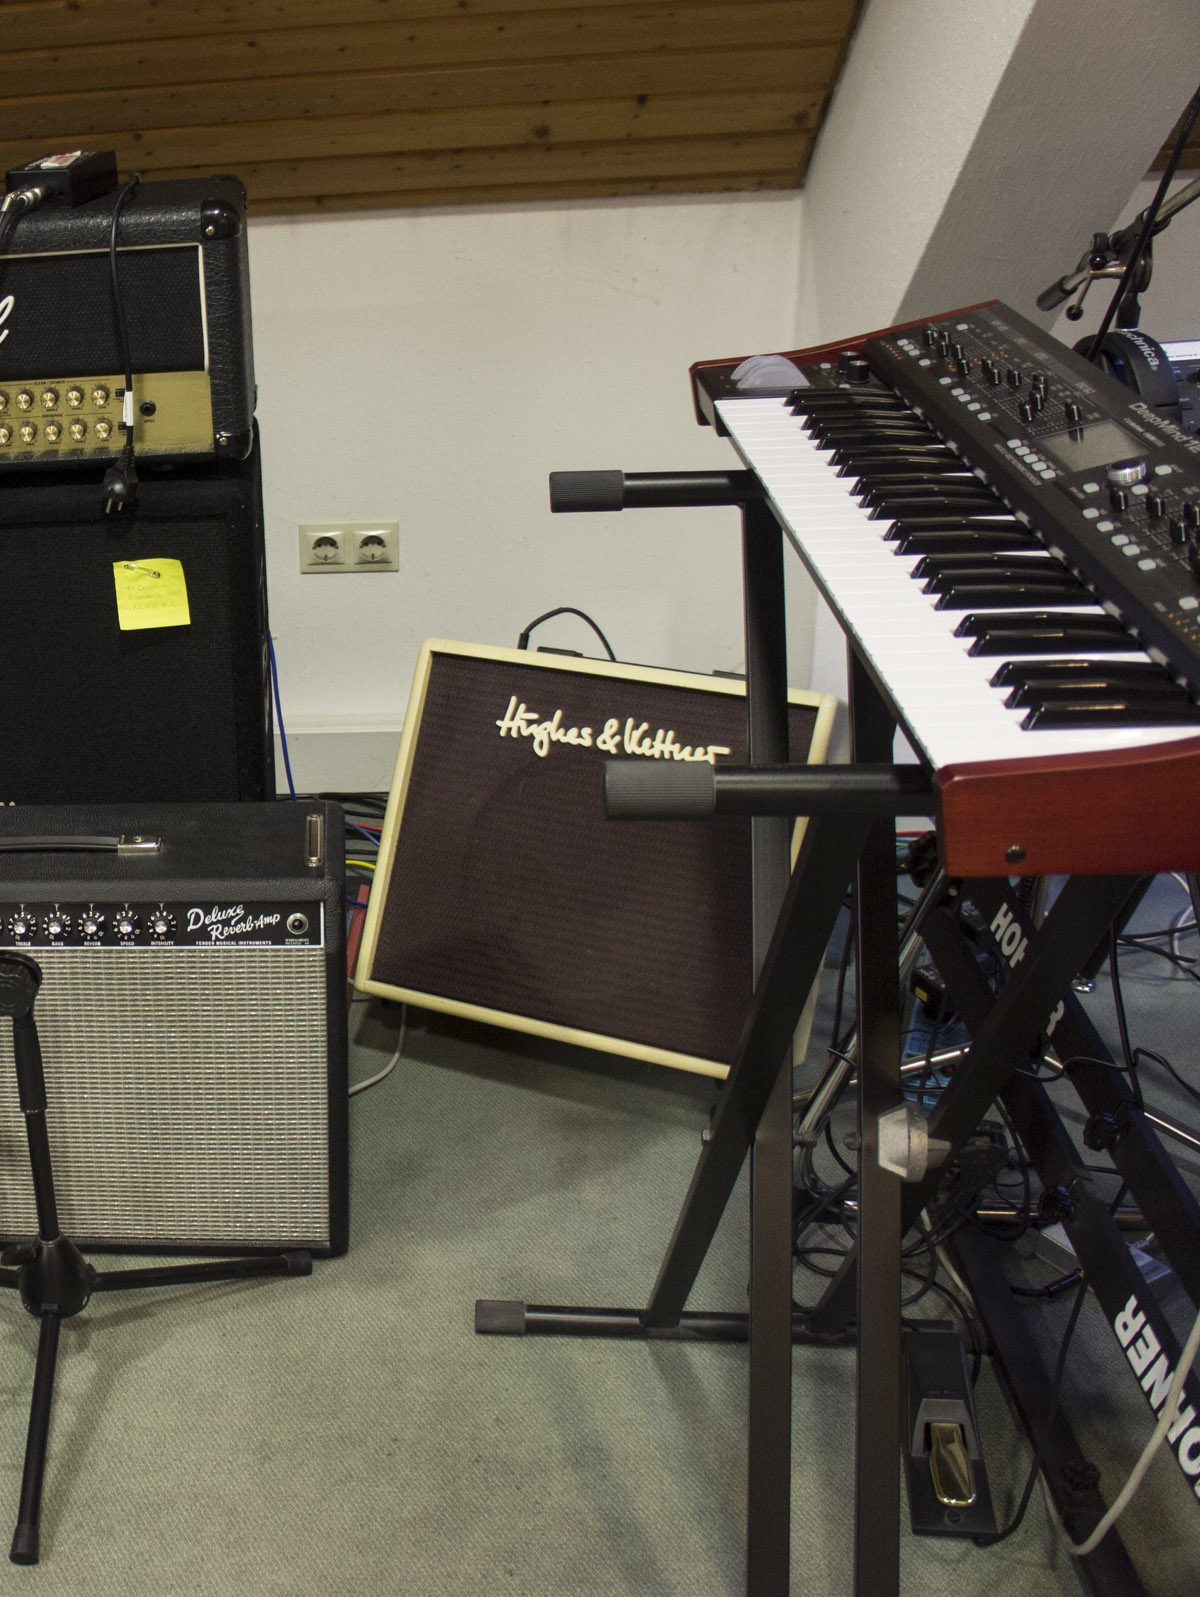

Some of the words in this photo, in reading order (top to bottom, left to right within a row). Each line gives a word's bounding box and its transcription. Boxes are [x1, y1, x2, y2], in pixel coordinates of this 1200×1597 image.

[1128, 402, 1193, 442] DeepMind
[496, 695, 593, 757] Hughes
[596, 718, 622, 754] &
[624, 717, 731, 765] Kettner
[186, 904, 244, 932] Deluxe
[1113, 1293, 1200, 1499] OHNER
